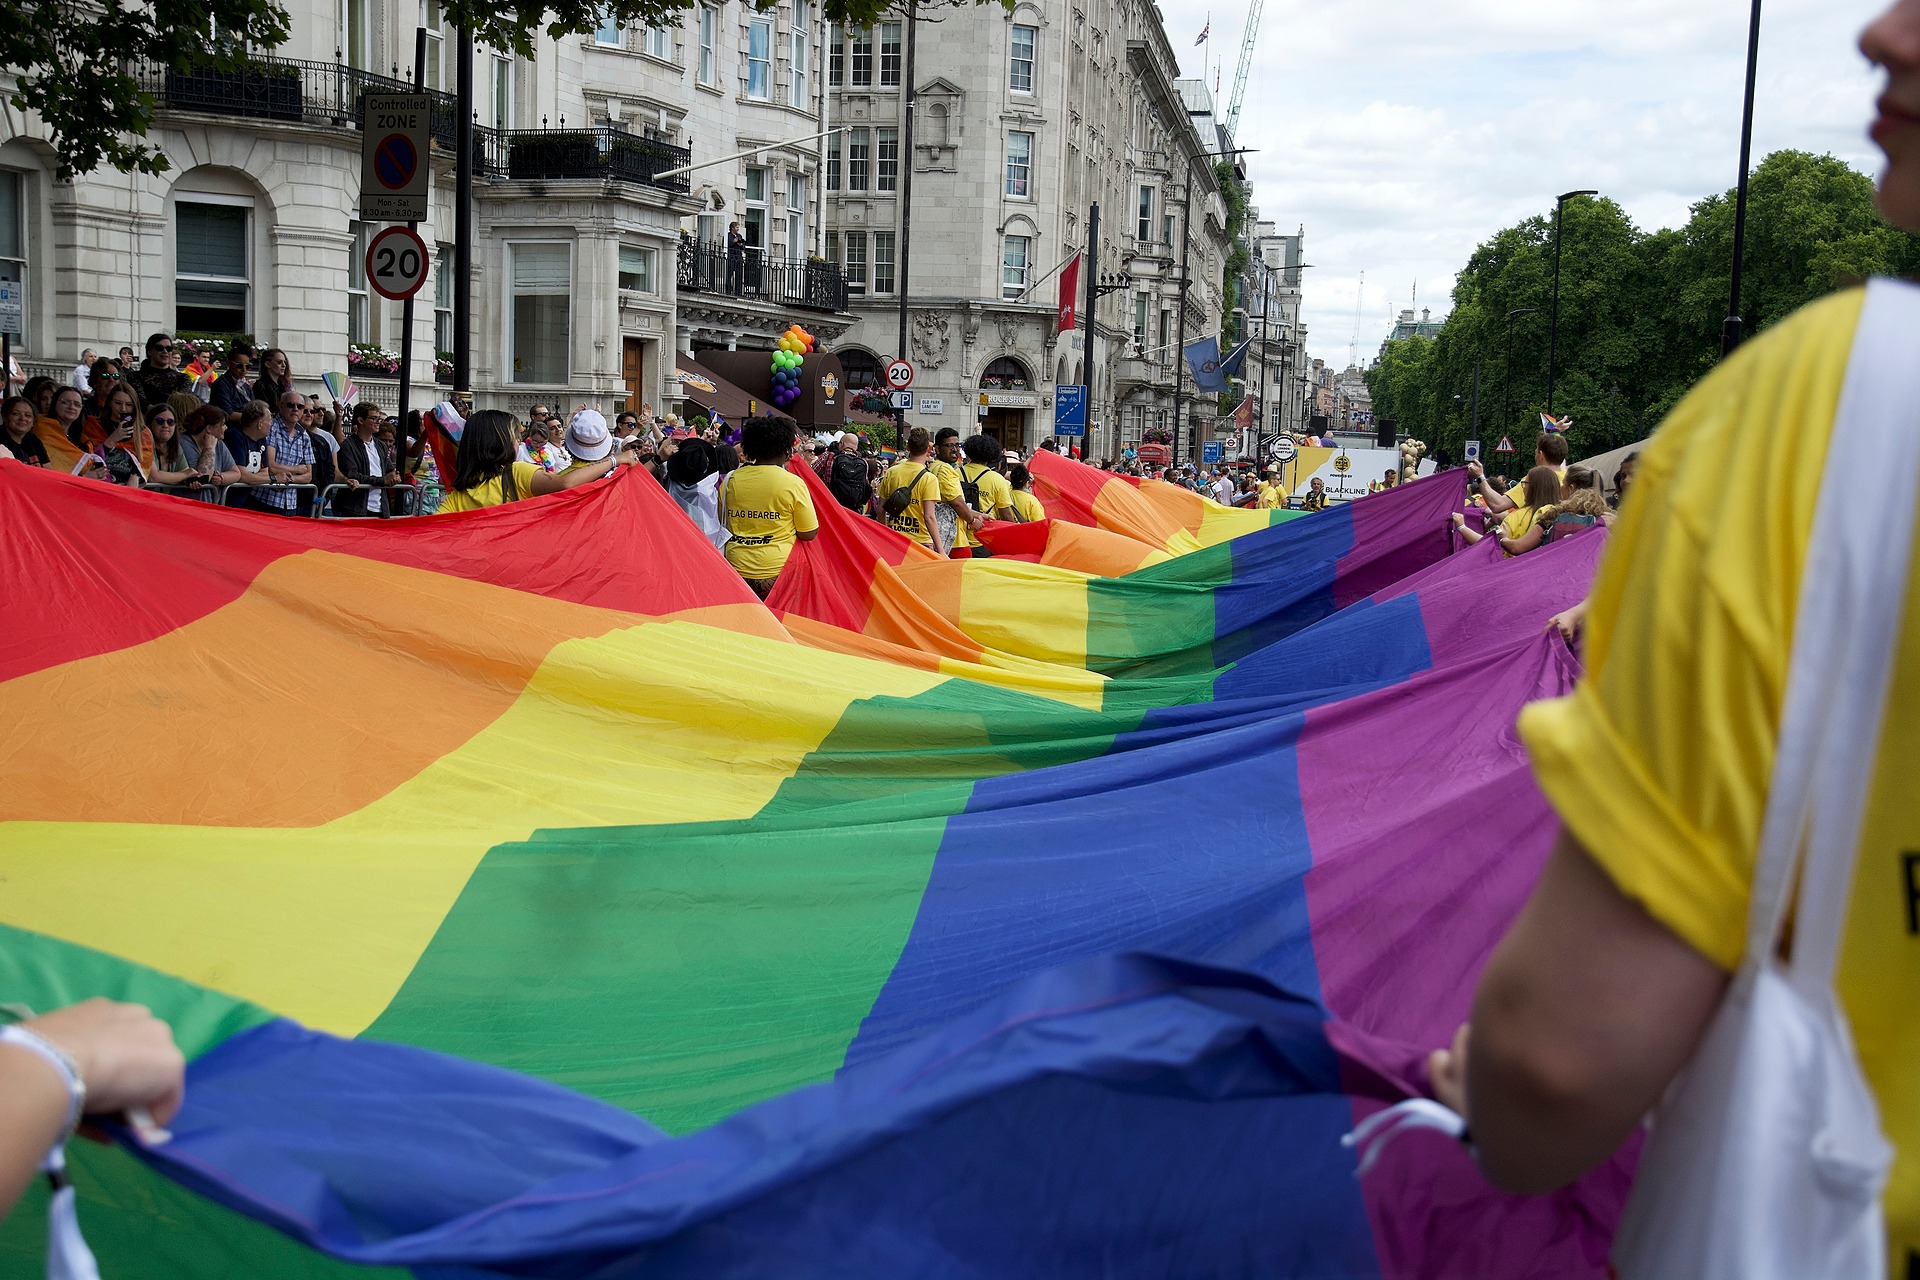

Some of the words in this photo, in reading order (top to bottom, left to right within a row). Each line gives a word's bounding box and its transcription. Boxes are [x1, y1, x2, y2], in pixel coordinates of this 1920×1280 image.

[370, 99, 426, 110] Controlled
[377, 115, 417, 128] ZONE
[376, 248, 420, 278] 20
[890, 368, 910, 380] 20
[902, 395, 908, 405] P
[988, 395, 1008, 403] ROCK
[1009, 396, 1028, 404] SHOP
[728, 510, 745, 518] FLAG
[748, 511, 780, 519] BEARER
